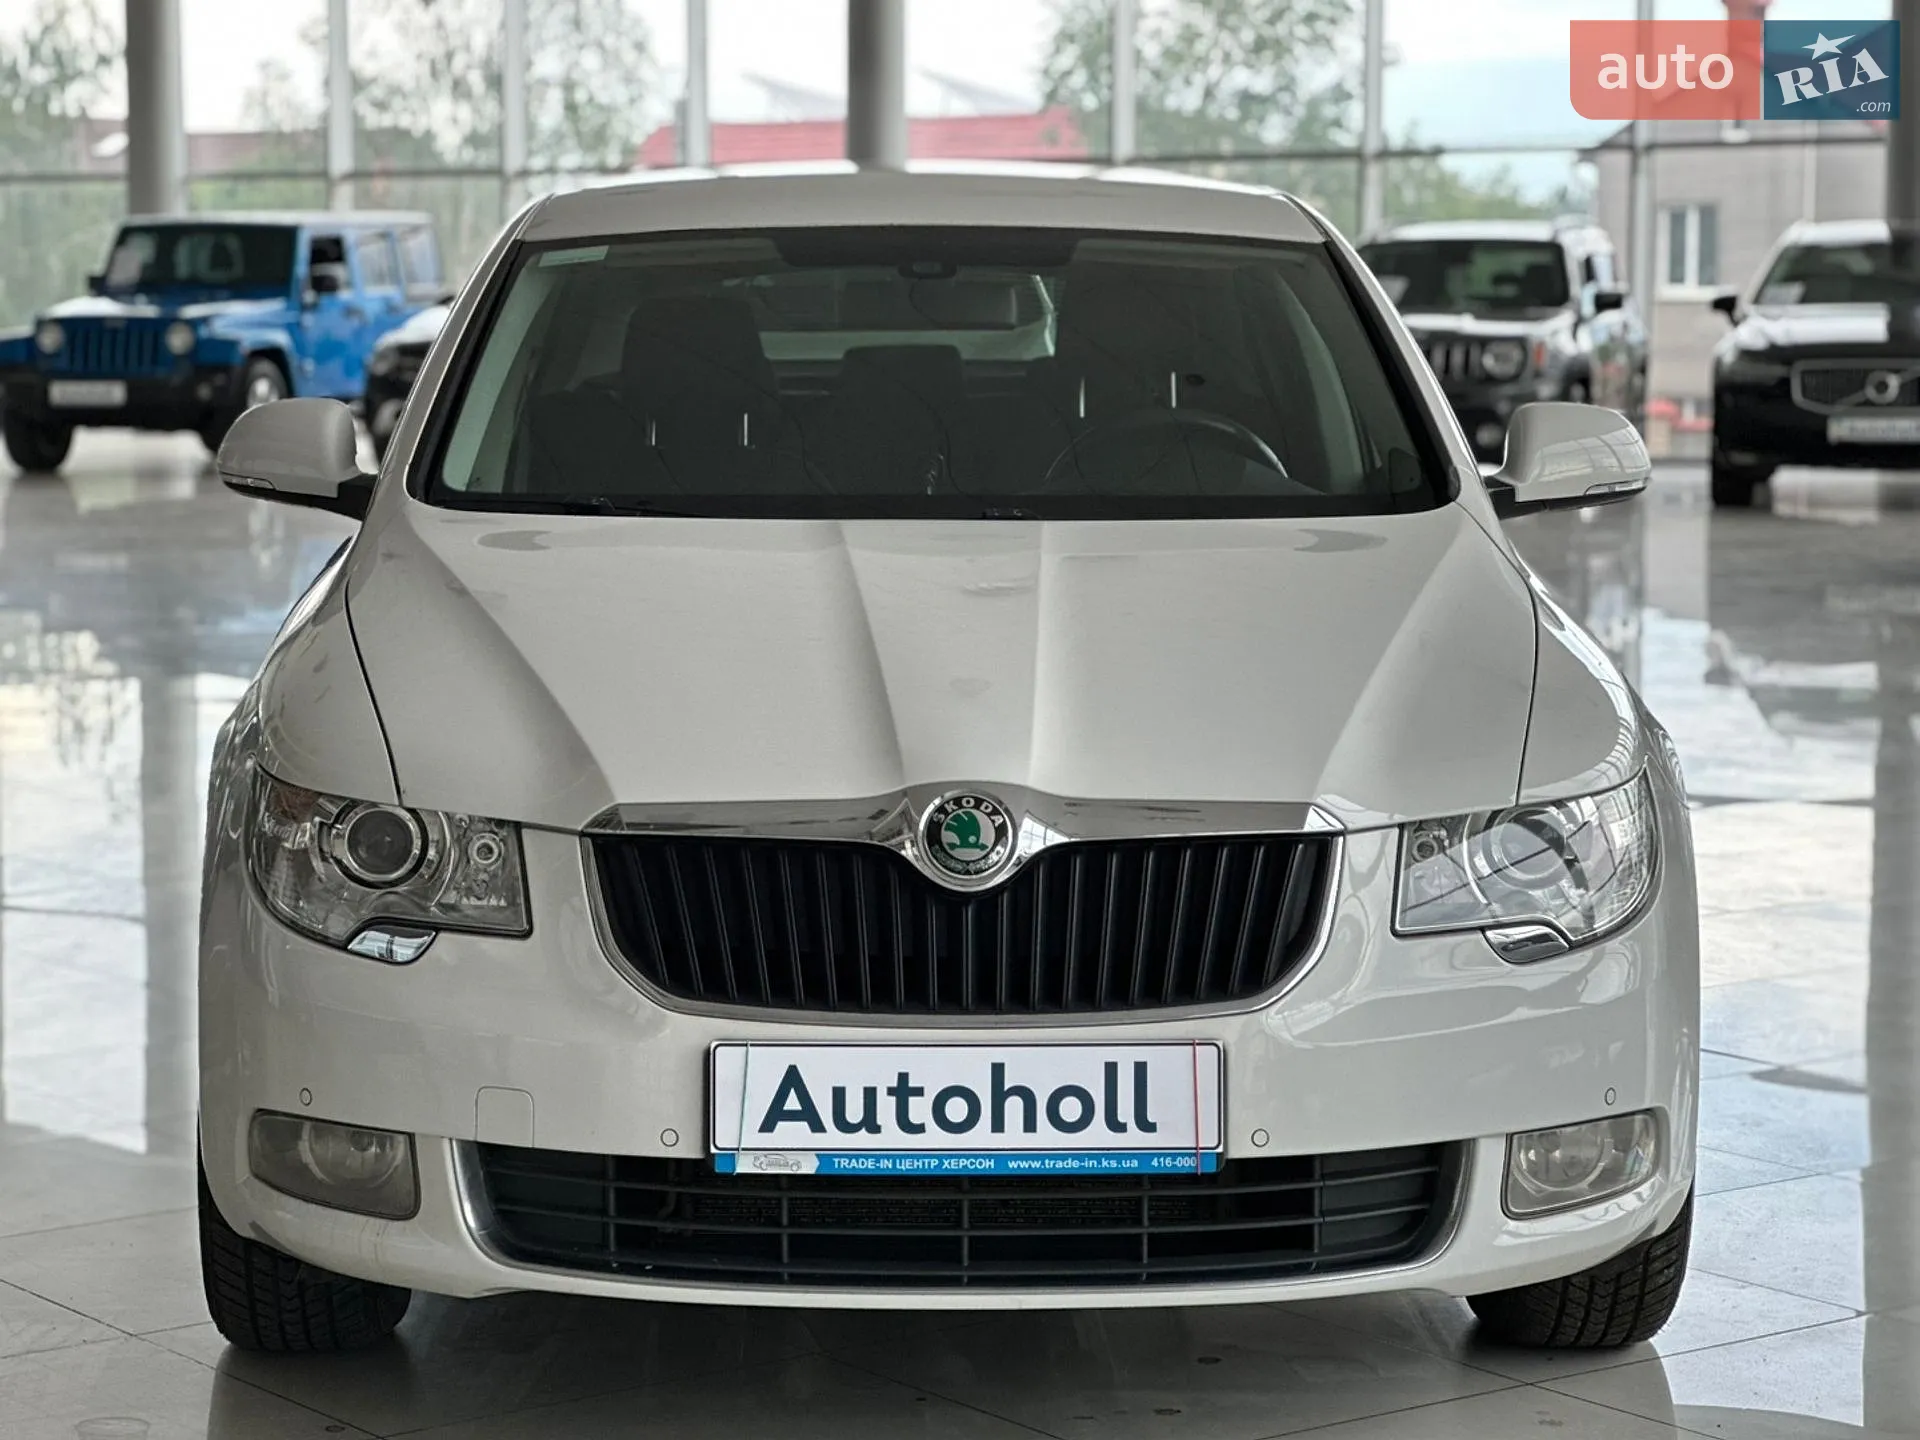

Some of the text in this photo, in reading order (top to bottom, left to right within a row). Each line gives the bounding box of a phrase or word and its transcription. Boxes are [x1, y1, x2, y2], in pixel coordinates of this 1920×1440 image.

[757, 1061, 1158, 1135] Autoholl
[832, 1157, 1197, 1171] TRADE-IN ЦЕНТР ХЕРСОН www.trade-in.ks.ua 416-000
